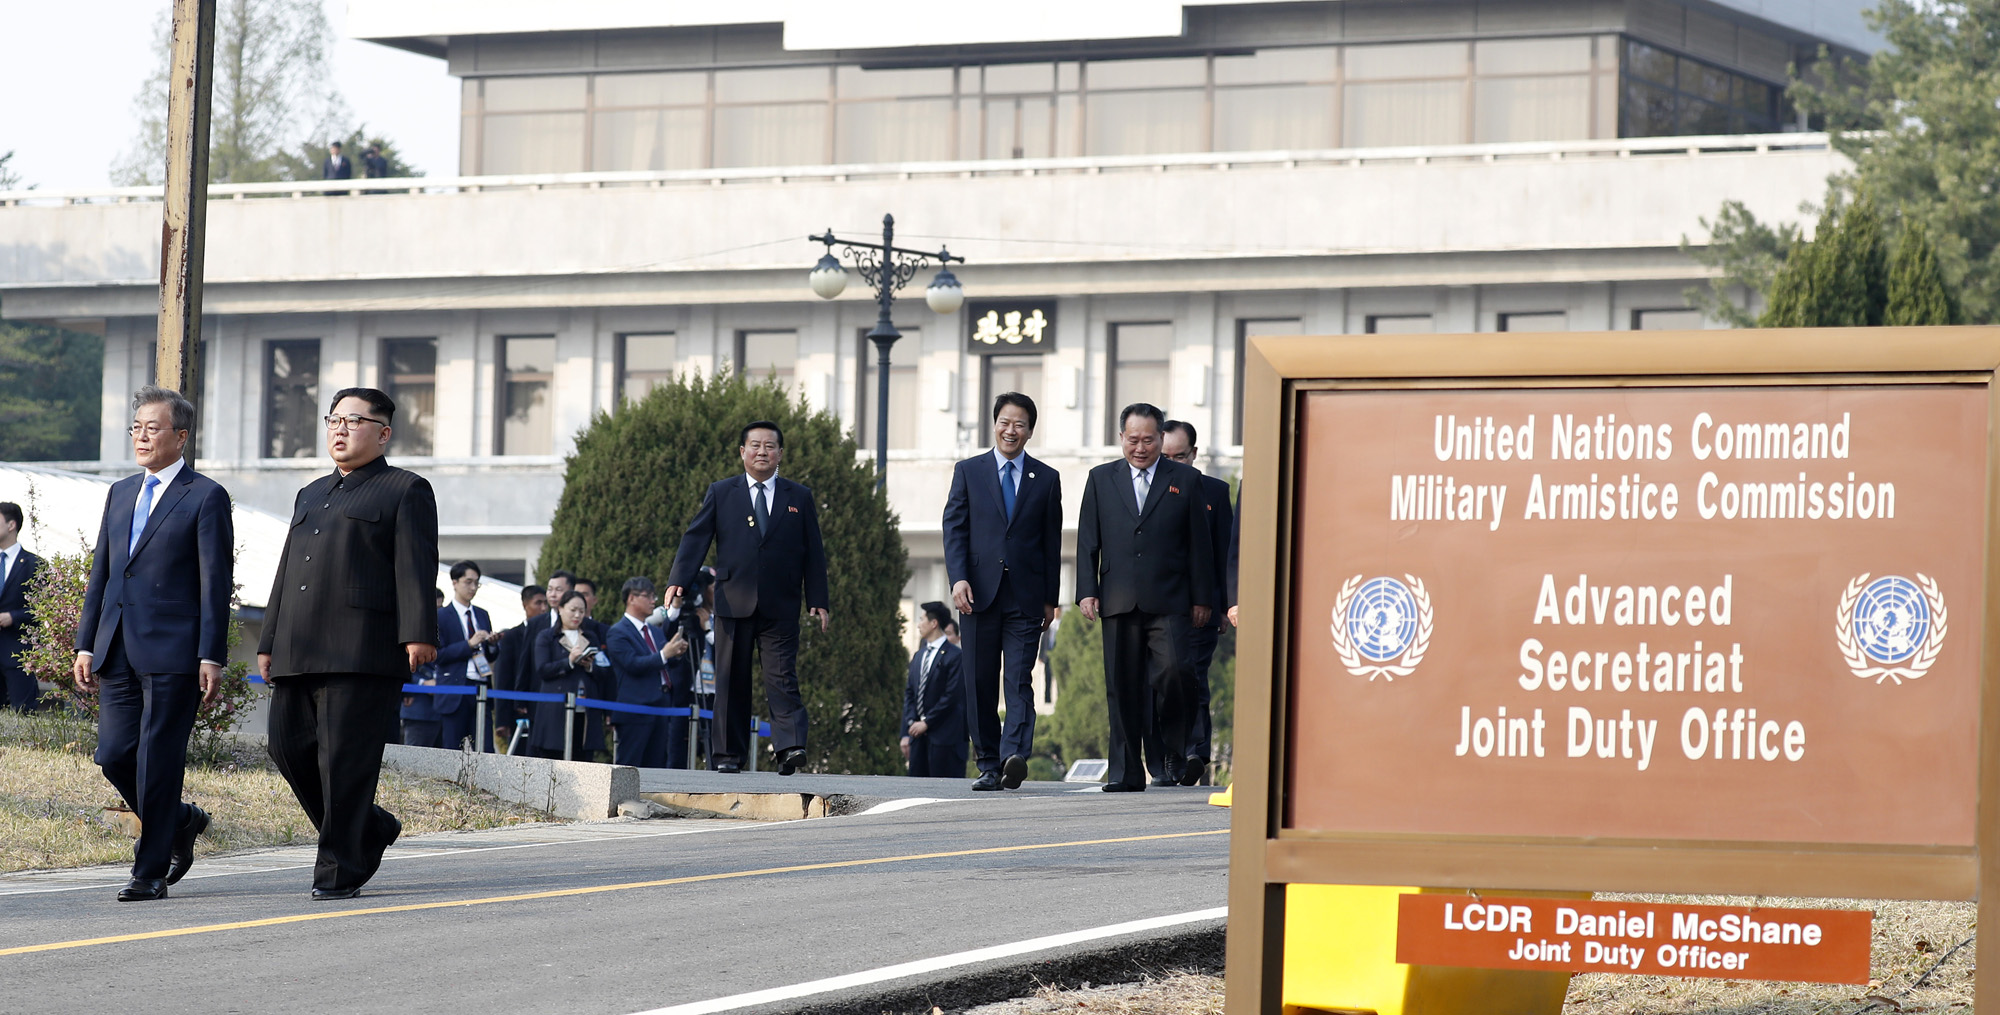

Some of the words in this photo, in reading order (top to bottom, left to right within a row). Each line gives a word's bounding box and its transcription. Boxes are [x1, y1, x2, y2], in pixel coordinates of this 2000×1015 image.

[1433, 413, 1536, 462] United
[1550, 412, 1673, 461] Nations
[1691, 411, 1851, 461] Command
[1390, 473, 1507, 532] Military
[1524, 472, 1679, 521] Armistice
[1696, 471, 1896, 520] Commission
[1533, 573, 1733, 627] Advanced
[1518, 637, 1744, 693] Secretariat
[1455, 705, 1546, 758] Joint
[1567, 706, 1658, 771] Duty
[1680, 706, 1806, 762] Office
[1444, 902, 1533, 933] LCDR
[1555, 907, 1655, 939] Daniel
[1671, 912, 1822, 946] McShane
[1508, 938, 1571, 963] Joint
[1584, 941, 1645, 970] Duty
[1656, 944, 1749, 970] Officer
